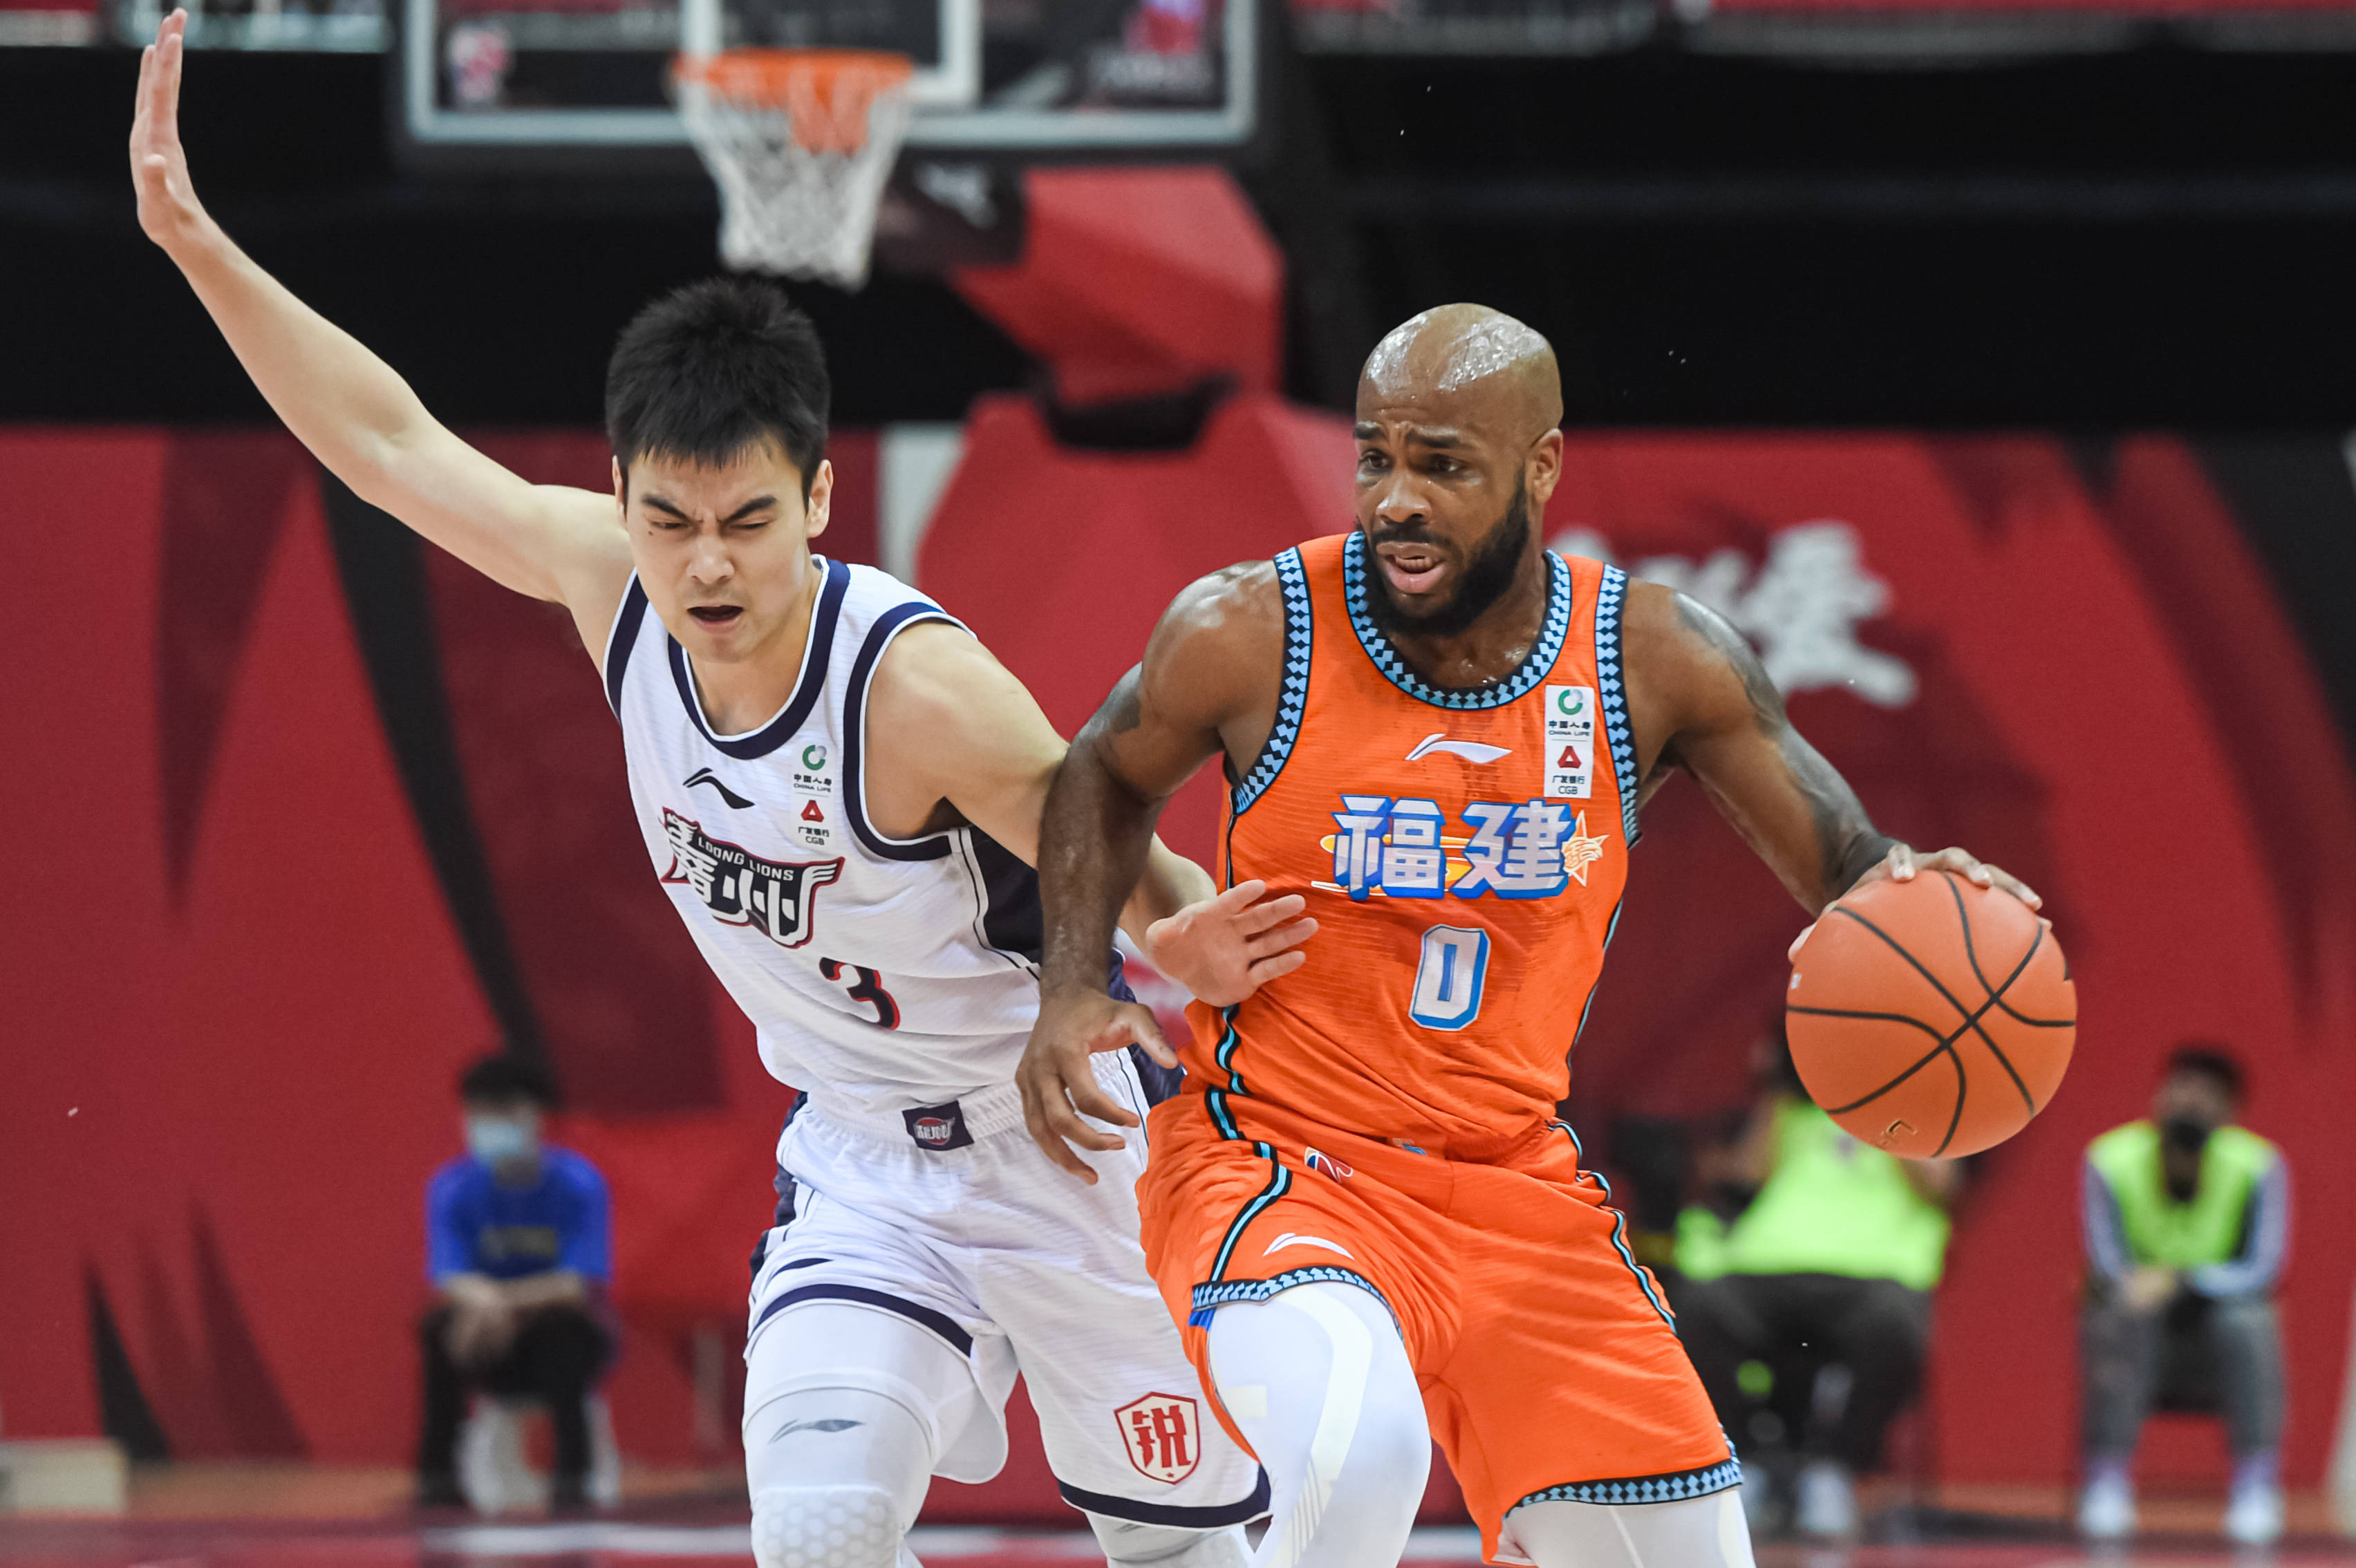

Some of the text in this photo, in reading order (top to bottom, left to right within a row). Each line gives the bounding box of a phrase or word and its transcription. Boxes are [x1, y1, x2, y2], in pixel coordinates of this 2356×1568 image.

[1558, 785, 1578, 794] CGB
[698, 836, 794, 881] LOONG LIONS
[805, 836, 825, 846] CGB
[1330, 794, 1576, 900] 福建
[819, 956, 900, 1030] 3
[1408, 924, 1490, 1032] 0
